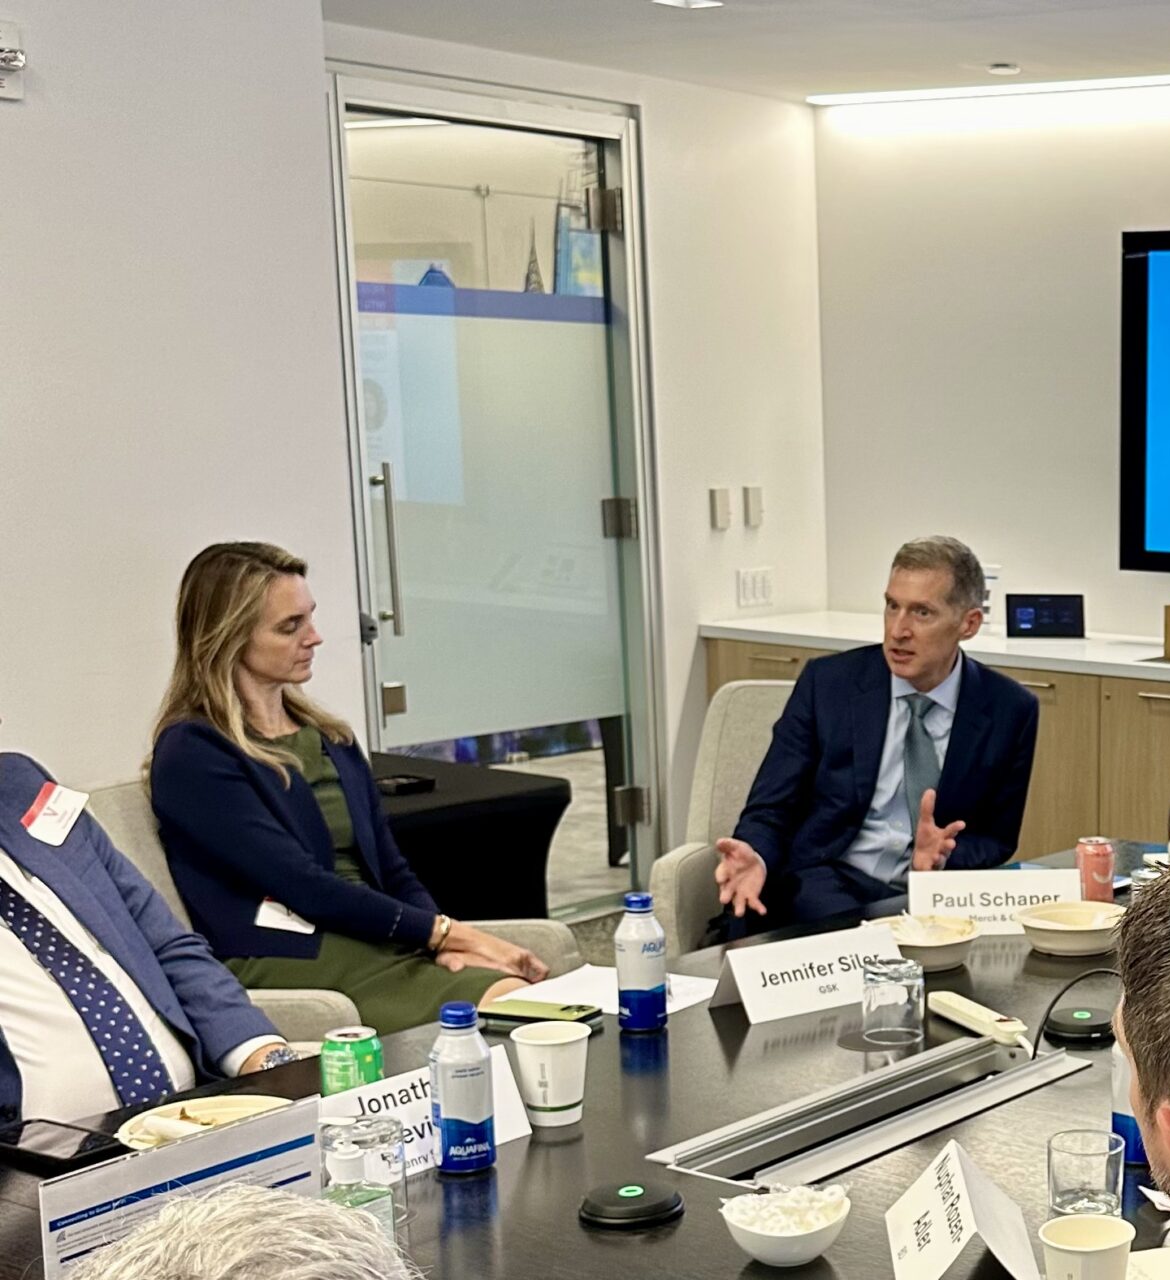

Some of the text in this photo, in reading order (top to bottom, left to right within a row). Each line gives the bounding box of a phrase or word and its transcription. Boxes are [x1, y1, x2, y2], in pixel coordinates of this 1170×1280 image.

[932, 892, 975, 908] Paul
[761, 962, 834, 988] Jennifer
[819, 983, 839, 994] GSK
[358, 1078, 431, 1116] Jonath
[403, 1115, 433, 1144] evi
[934, 1153, 963, 1243] Nuphar Rozen-
[913, 1210, 934, 1252] Adler
